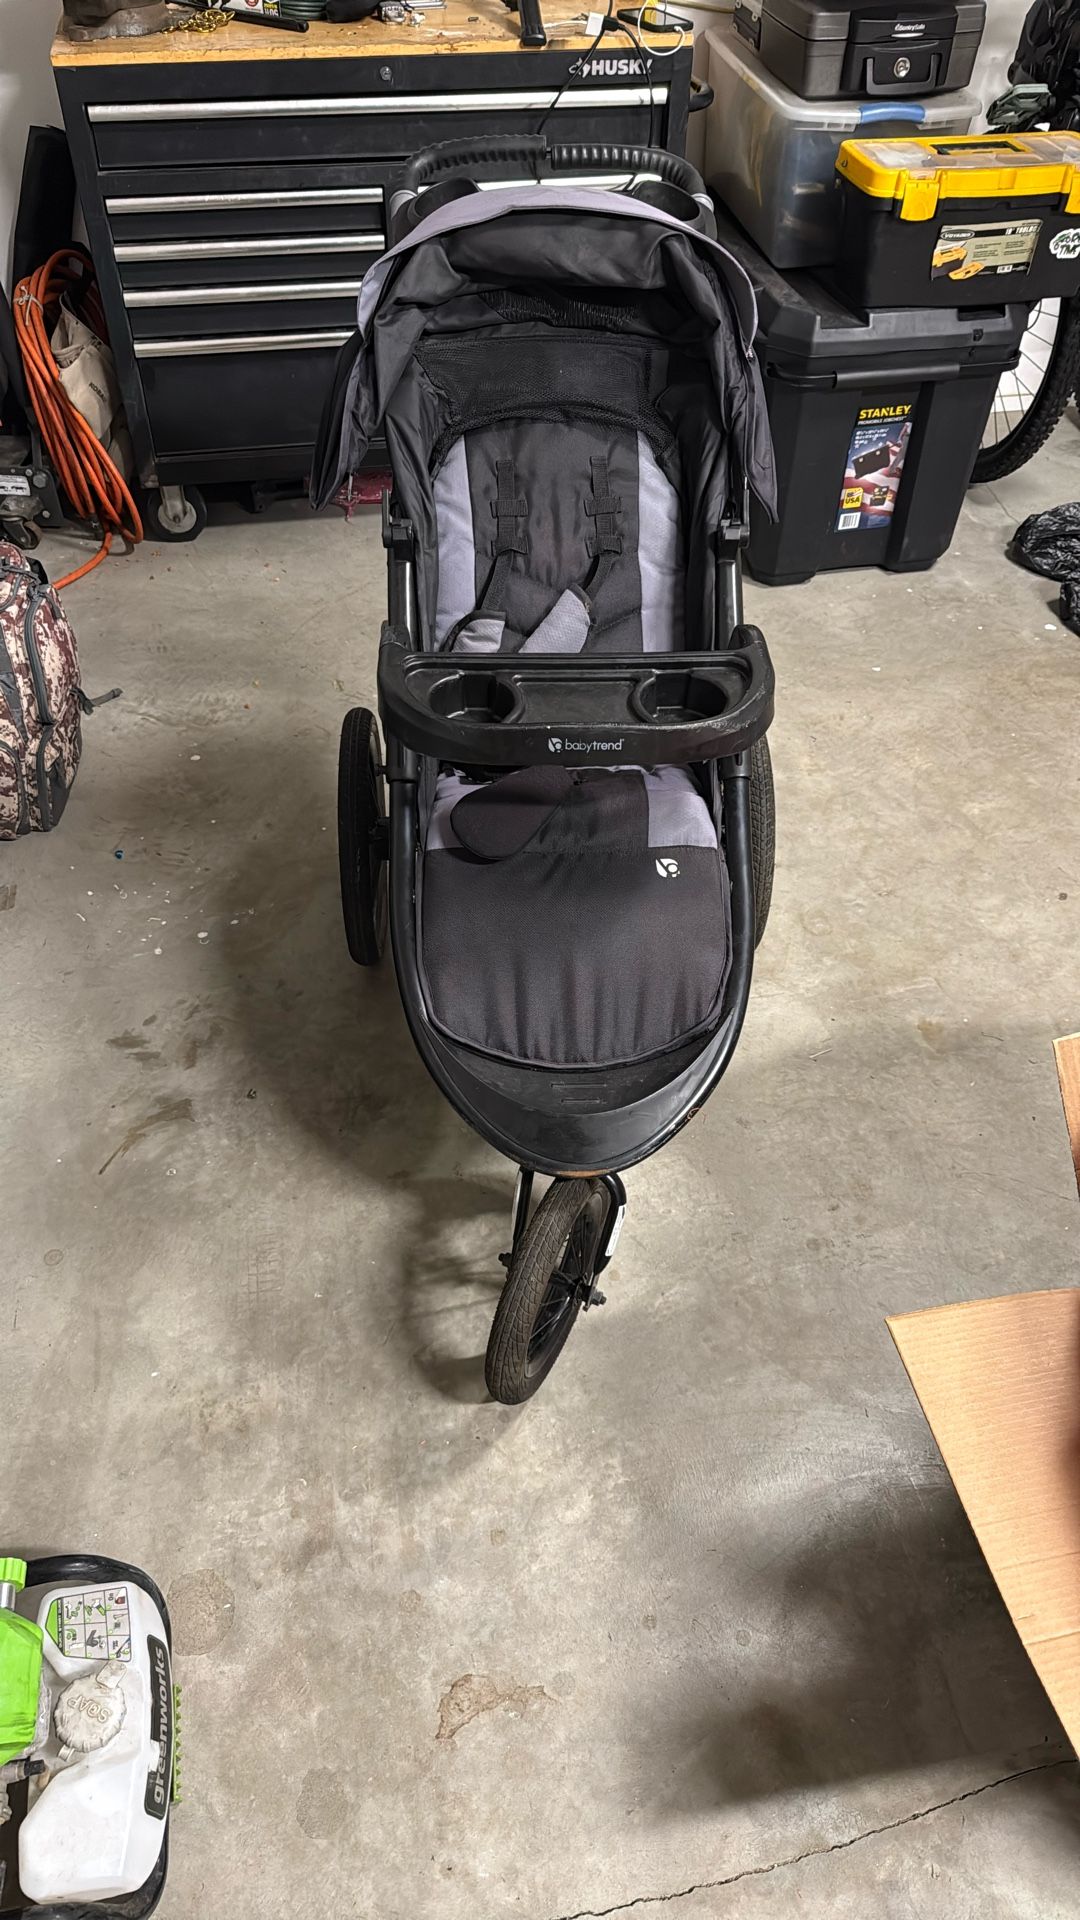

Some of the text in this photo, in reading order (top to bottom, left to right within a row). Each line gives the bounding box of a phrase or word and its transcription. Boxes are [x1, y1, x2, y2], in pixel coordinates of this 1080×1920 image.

[591, 59, 653, 76] HUSKY
[89, 382, 107, 402] KOBA
[859, 404, 912, 419] STANLEY
[845, 496, 860, 504] USA
[565, 738, 622, 753] babytrend
[67, 1695, 112, 1724] SOAP
[153, 1646, 168, 1804] greenworks
